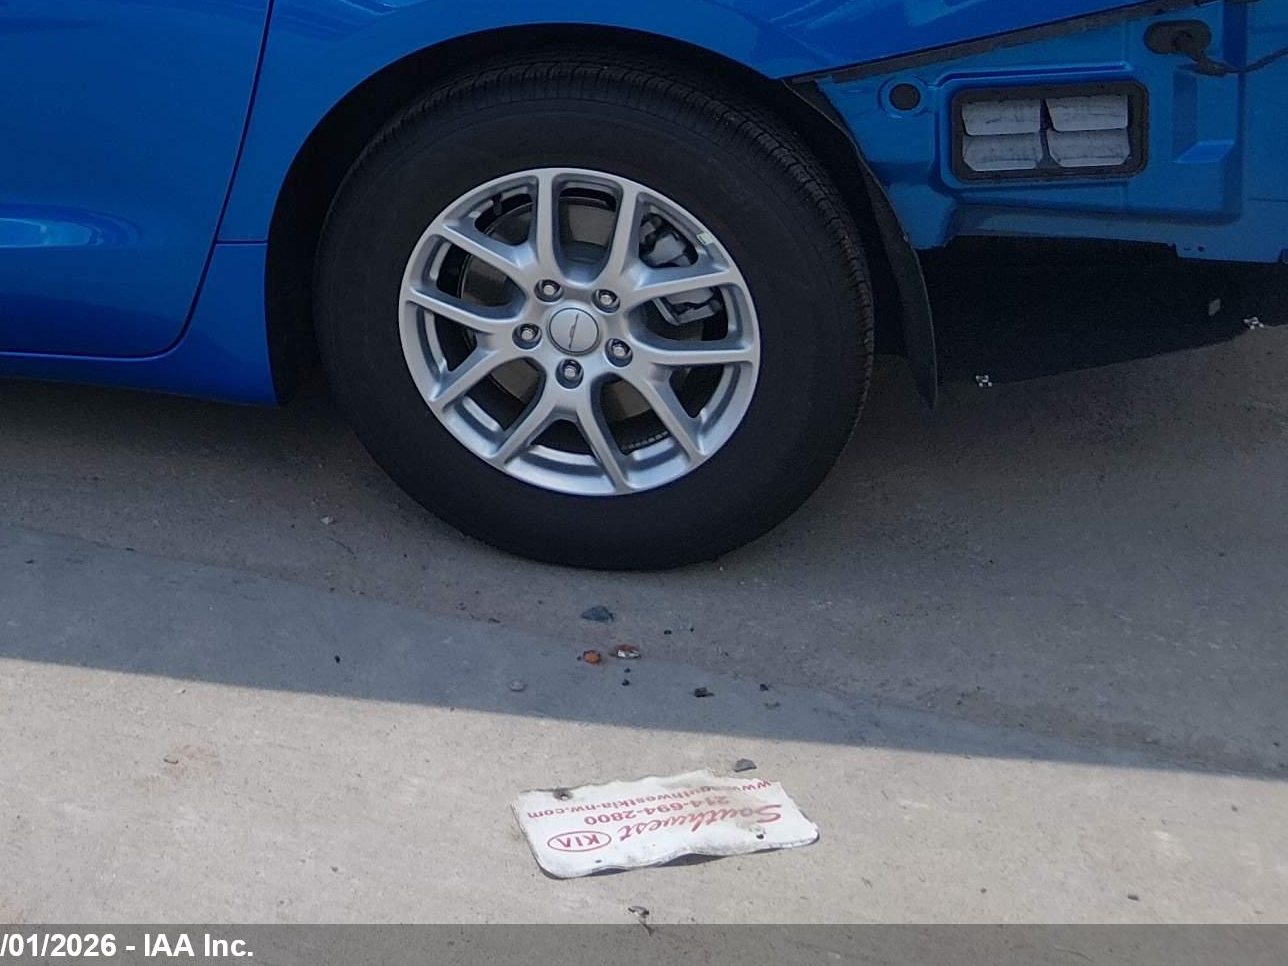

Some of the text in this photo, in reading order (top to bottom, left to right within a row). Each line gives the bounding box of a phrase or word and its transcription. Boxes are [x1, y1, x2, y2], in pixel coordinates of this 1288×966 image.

[526, 778, 772, 819] wwwouthwestkia-nw.com
[583, 795, 731, 826] 214-694-2800
[616, 803, 783, 842] Southwest
[556, 833, 601, 849] KIA
